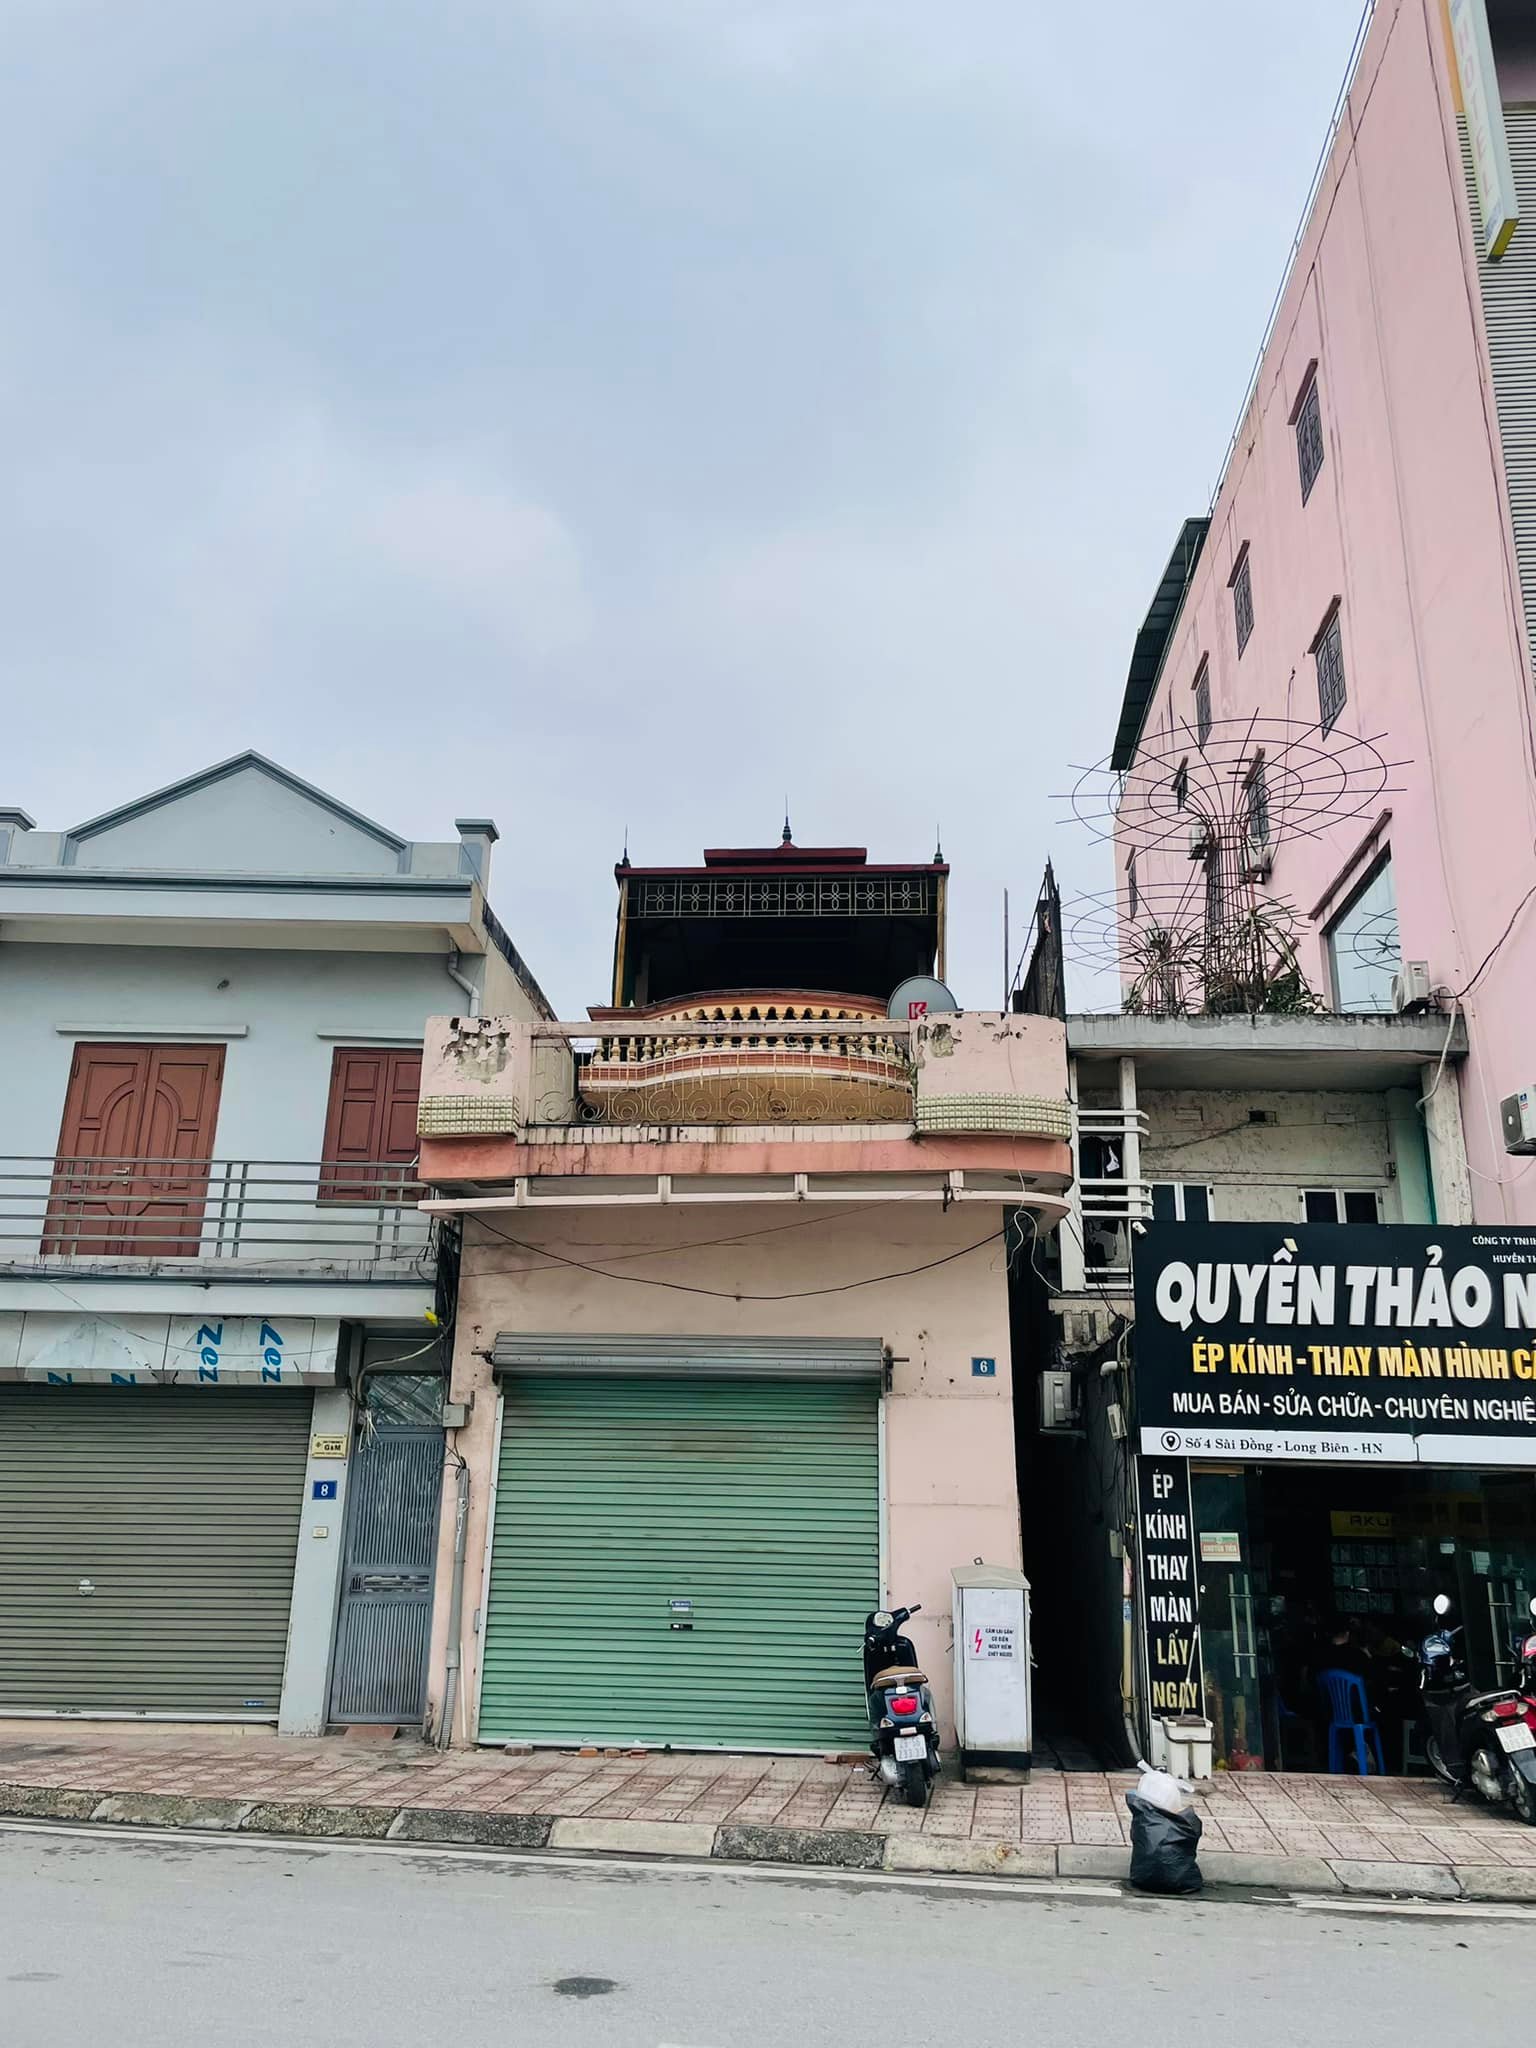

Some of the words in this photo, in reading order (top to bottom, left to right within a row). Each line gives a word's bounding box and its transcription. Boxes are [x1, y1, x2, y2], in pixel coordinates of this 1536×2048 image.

[1472, 1235, 1498, 1245] CÔNG
[1499, 1237, 1511, 1245] TY
[1155, 1238, 1335, 1331] QUYỀN
[1346, 1245, 1493, 1328] THẢO
[980, 1360, 988, 1373] 6
[1192, 1336, 1225, 1373] ÉP
[1229, 1337, 1294, 1375] KÍNH
[1307, 1346, 1371, 1376] THAY
[1378, 1340, 1442, 1377] MÀN
[1445, 1341, 1510, 1379] HÌNH
[1172, 1392, 1215, 1413] MUA
[1219, 1389, 1261, 1415] BÁN
[1273, 1387, 1313, 1416] SỬA
[1318, 1391, 1374, 1418] CHỮA
[1384, 1393, 1469, 1419] CHUYÊN
[1184, 1436, 1203, 1449] Số
[1204, 1439, 1211, 1449] 4
[1215, 1438, 1236, 1450] Sài
[1240, 1437, 1273, 1453] Đồng
[1284, 1441, 1316, 1454] Long
[1321, 1441, 1349, 1453] Biên
[1361, 1443, 1383, 1454] HN
[321, 1484, 329, 1497] 8
[1153, 1469, 1174, 1498] ÉP
[1145, 1509, 1187, 1539] KÍNH
[1147, 1555, 1188, 1581] THAY
[1150, 1592, 1192, 1622] MÀN
[1156, 1629, 1188, 1666] LẤY
[1152, 1681, 1198, 1709] NGAY
